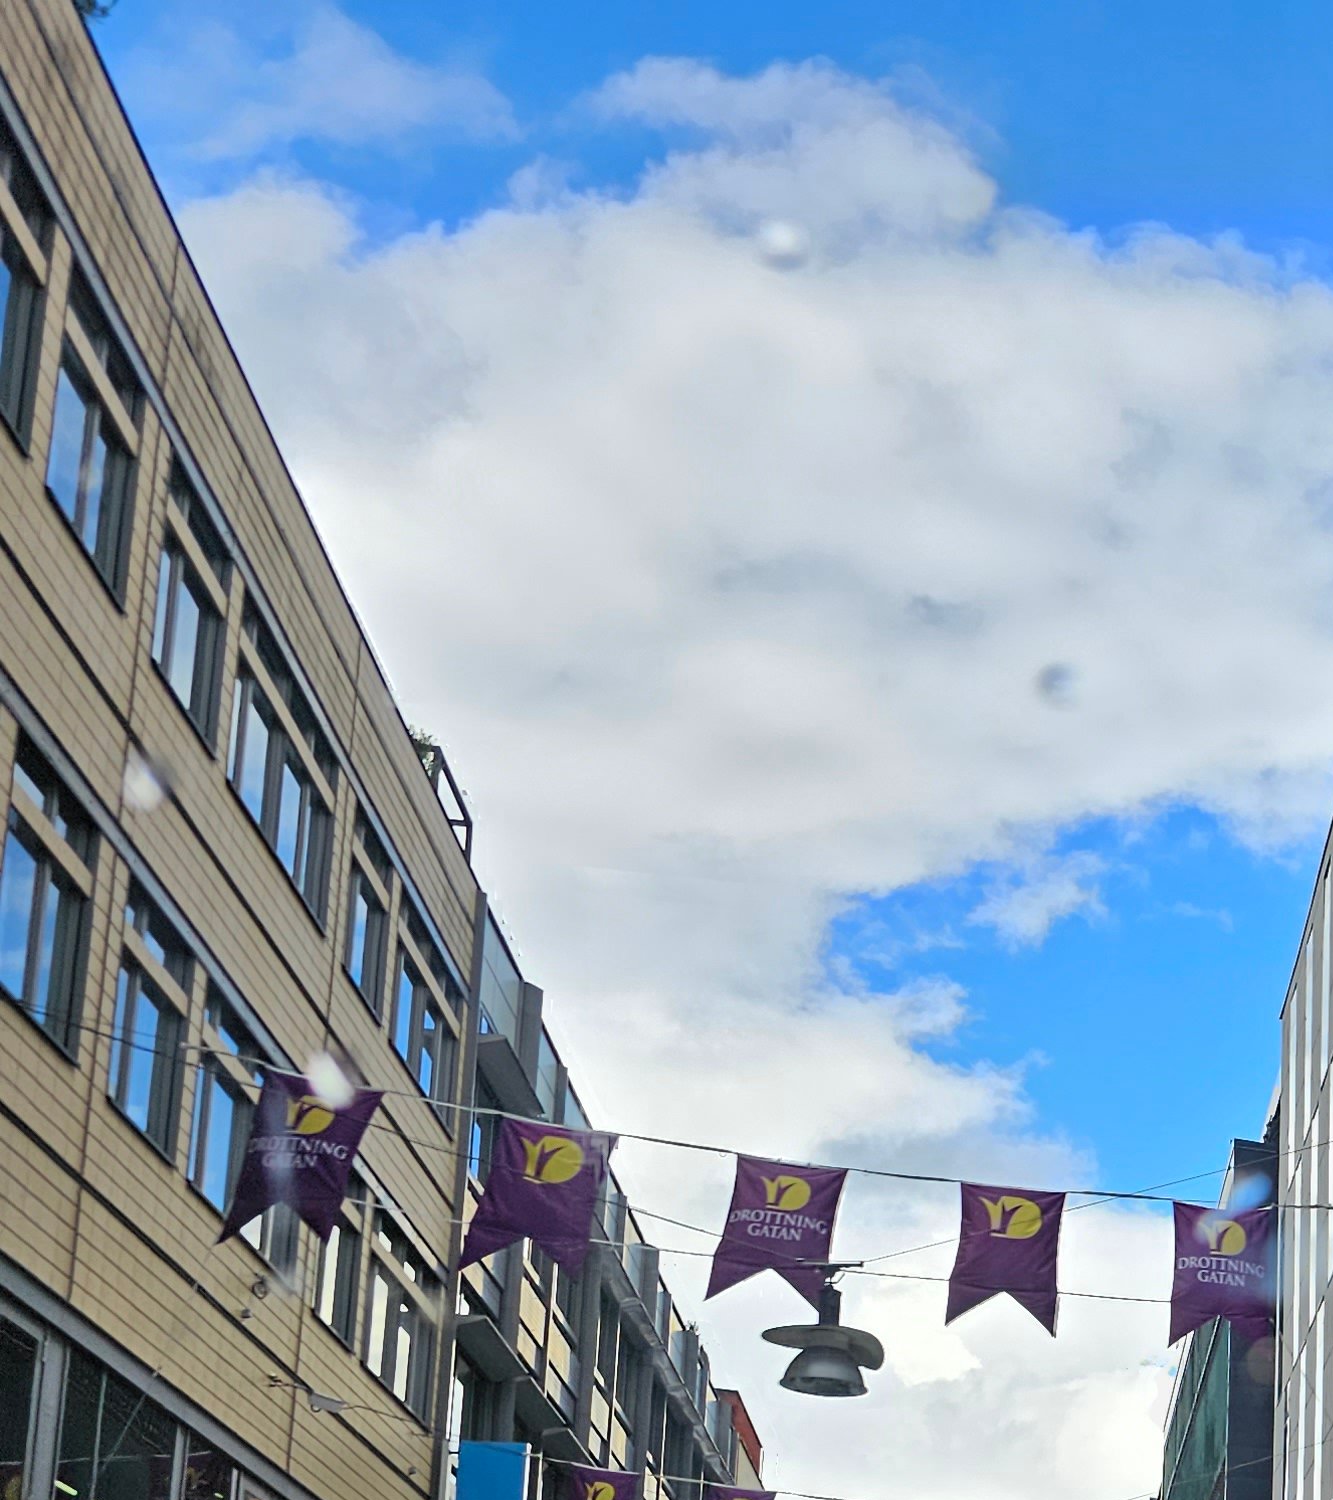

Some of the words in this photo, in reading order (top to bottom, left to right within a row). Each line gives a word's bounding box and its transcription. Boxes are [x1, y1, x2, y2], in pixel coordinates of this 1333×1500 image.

[729, 1209, 828, 1234] DROTTNING
[747, 1223, 802, 1240] GATAN
[1178, 1256, 1264, 1278] DROTTNING
[1197, 1270, 1245, 1286] GATAN
